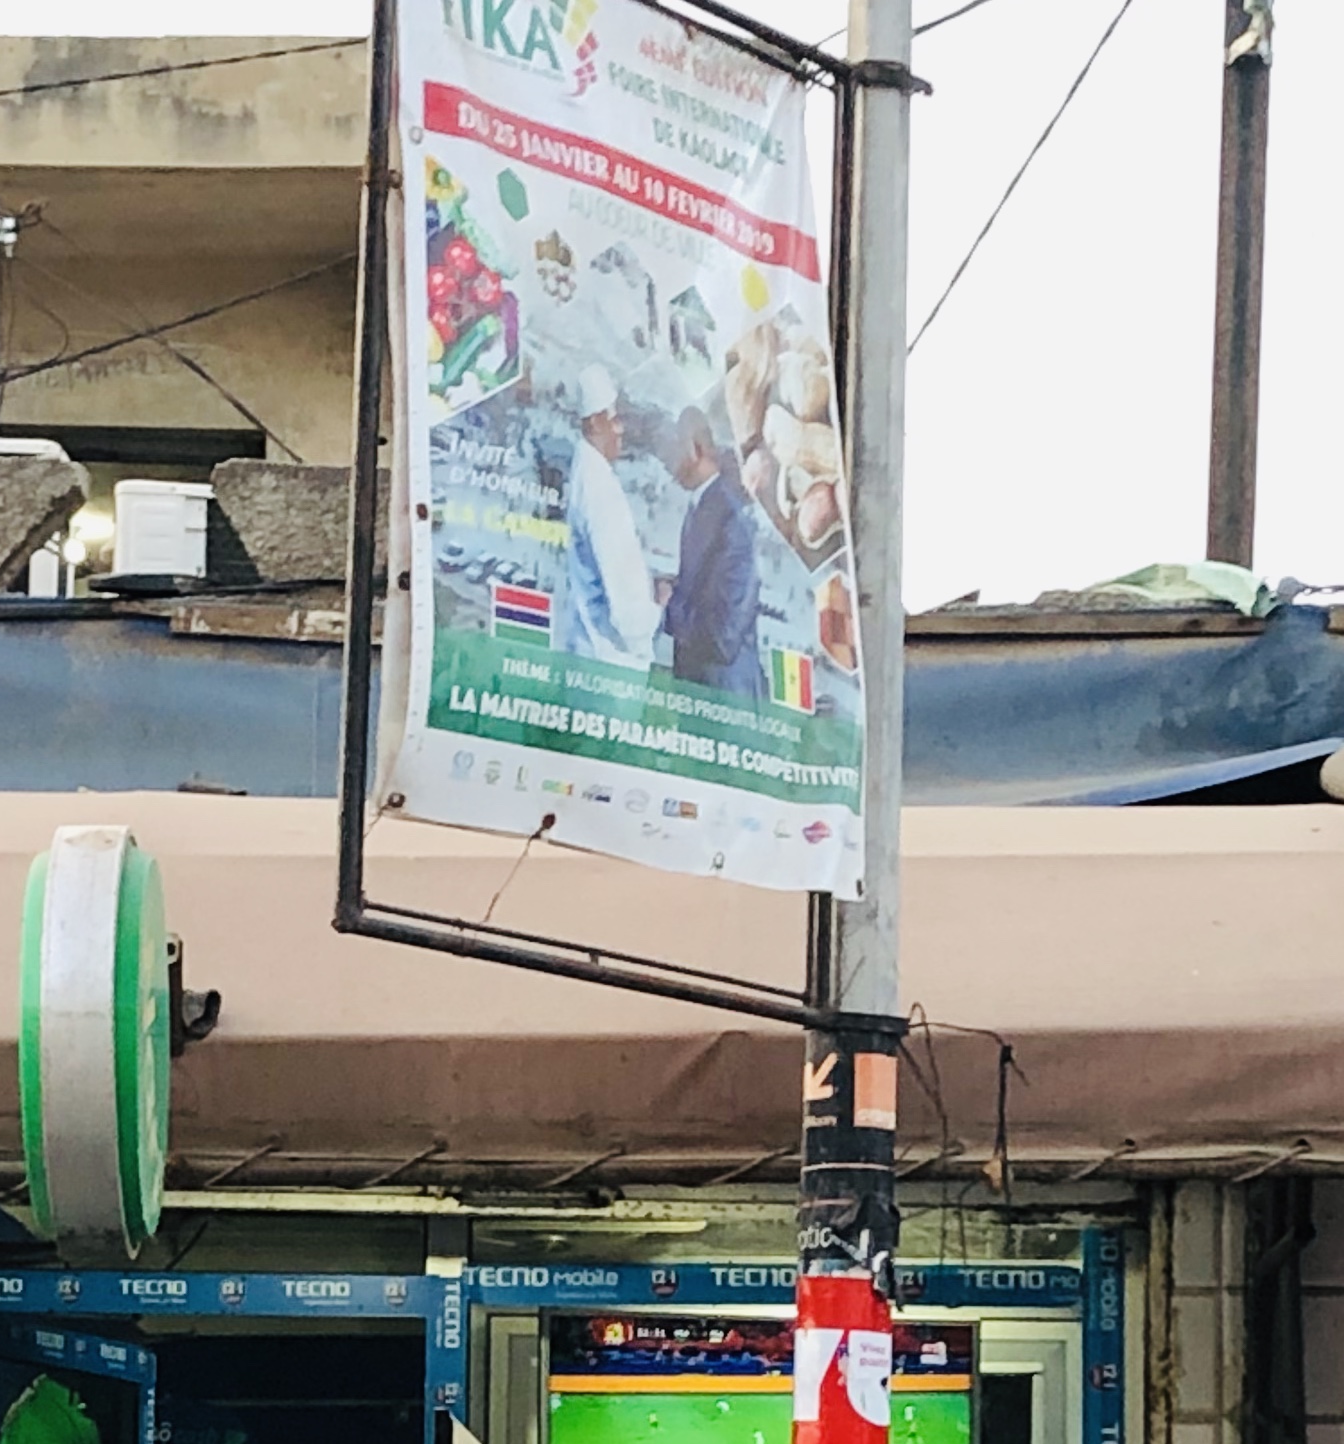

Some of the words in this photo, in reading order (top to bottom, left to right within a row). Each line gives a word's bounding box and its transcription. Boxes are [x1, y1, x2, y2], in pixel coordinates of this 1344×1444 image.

[457, 101, 489, 136] DU
[491, 118, 518, 149] 25
[520, 129, 611, 182] JANVIER
[612, 162, 640, 193] AU
[643, 176, 666, 206] 10
[737, 219, 775, 255] 2019
[565, 669, 665, 707] VALORISATION
[666, 692, 693, 715] DES
[694, 699, 757, 731] PRODUITS
[758, 717, 802, 743] LOCAUX
[449, 684, 477, 713] LA
[571, 709, 606, 739] DES
[718, 742, 740, 767] DE
[120, 1278, 187, 1296] TECNO
[466, 1266, 550, 1287] TECNO
[709, 1266, 797, 1288] TECNO
[958, 1269, 1046, 1290] TECNO
[282, 1280, 351, 1298] TECNO
[444, 1280, 460, 1349] TECNO
